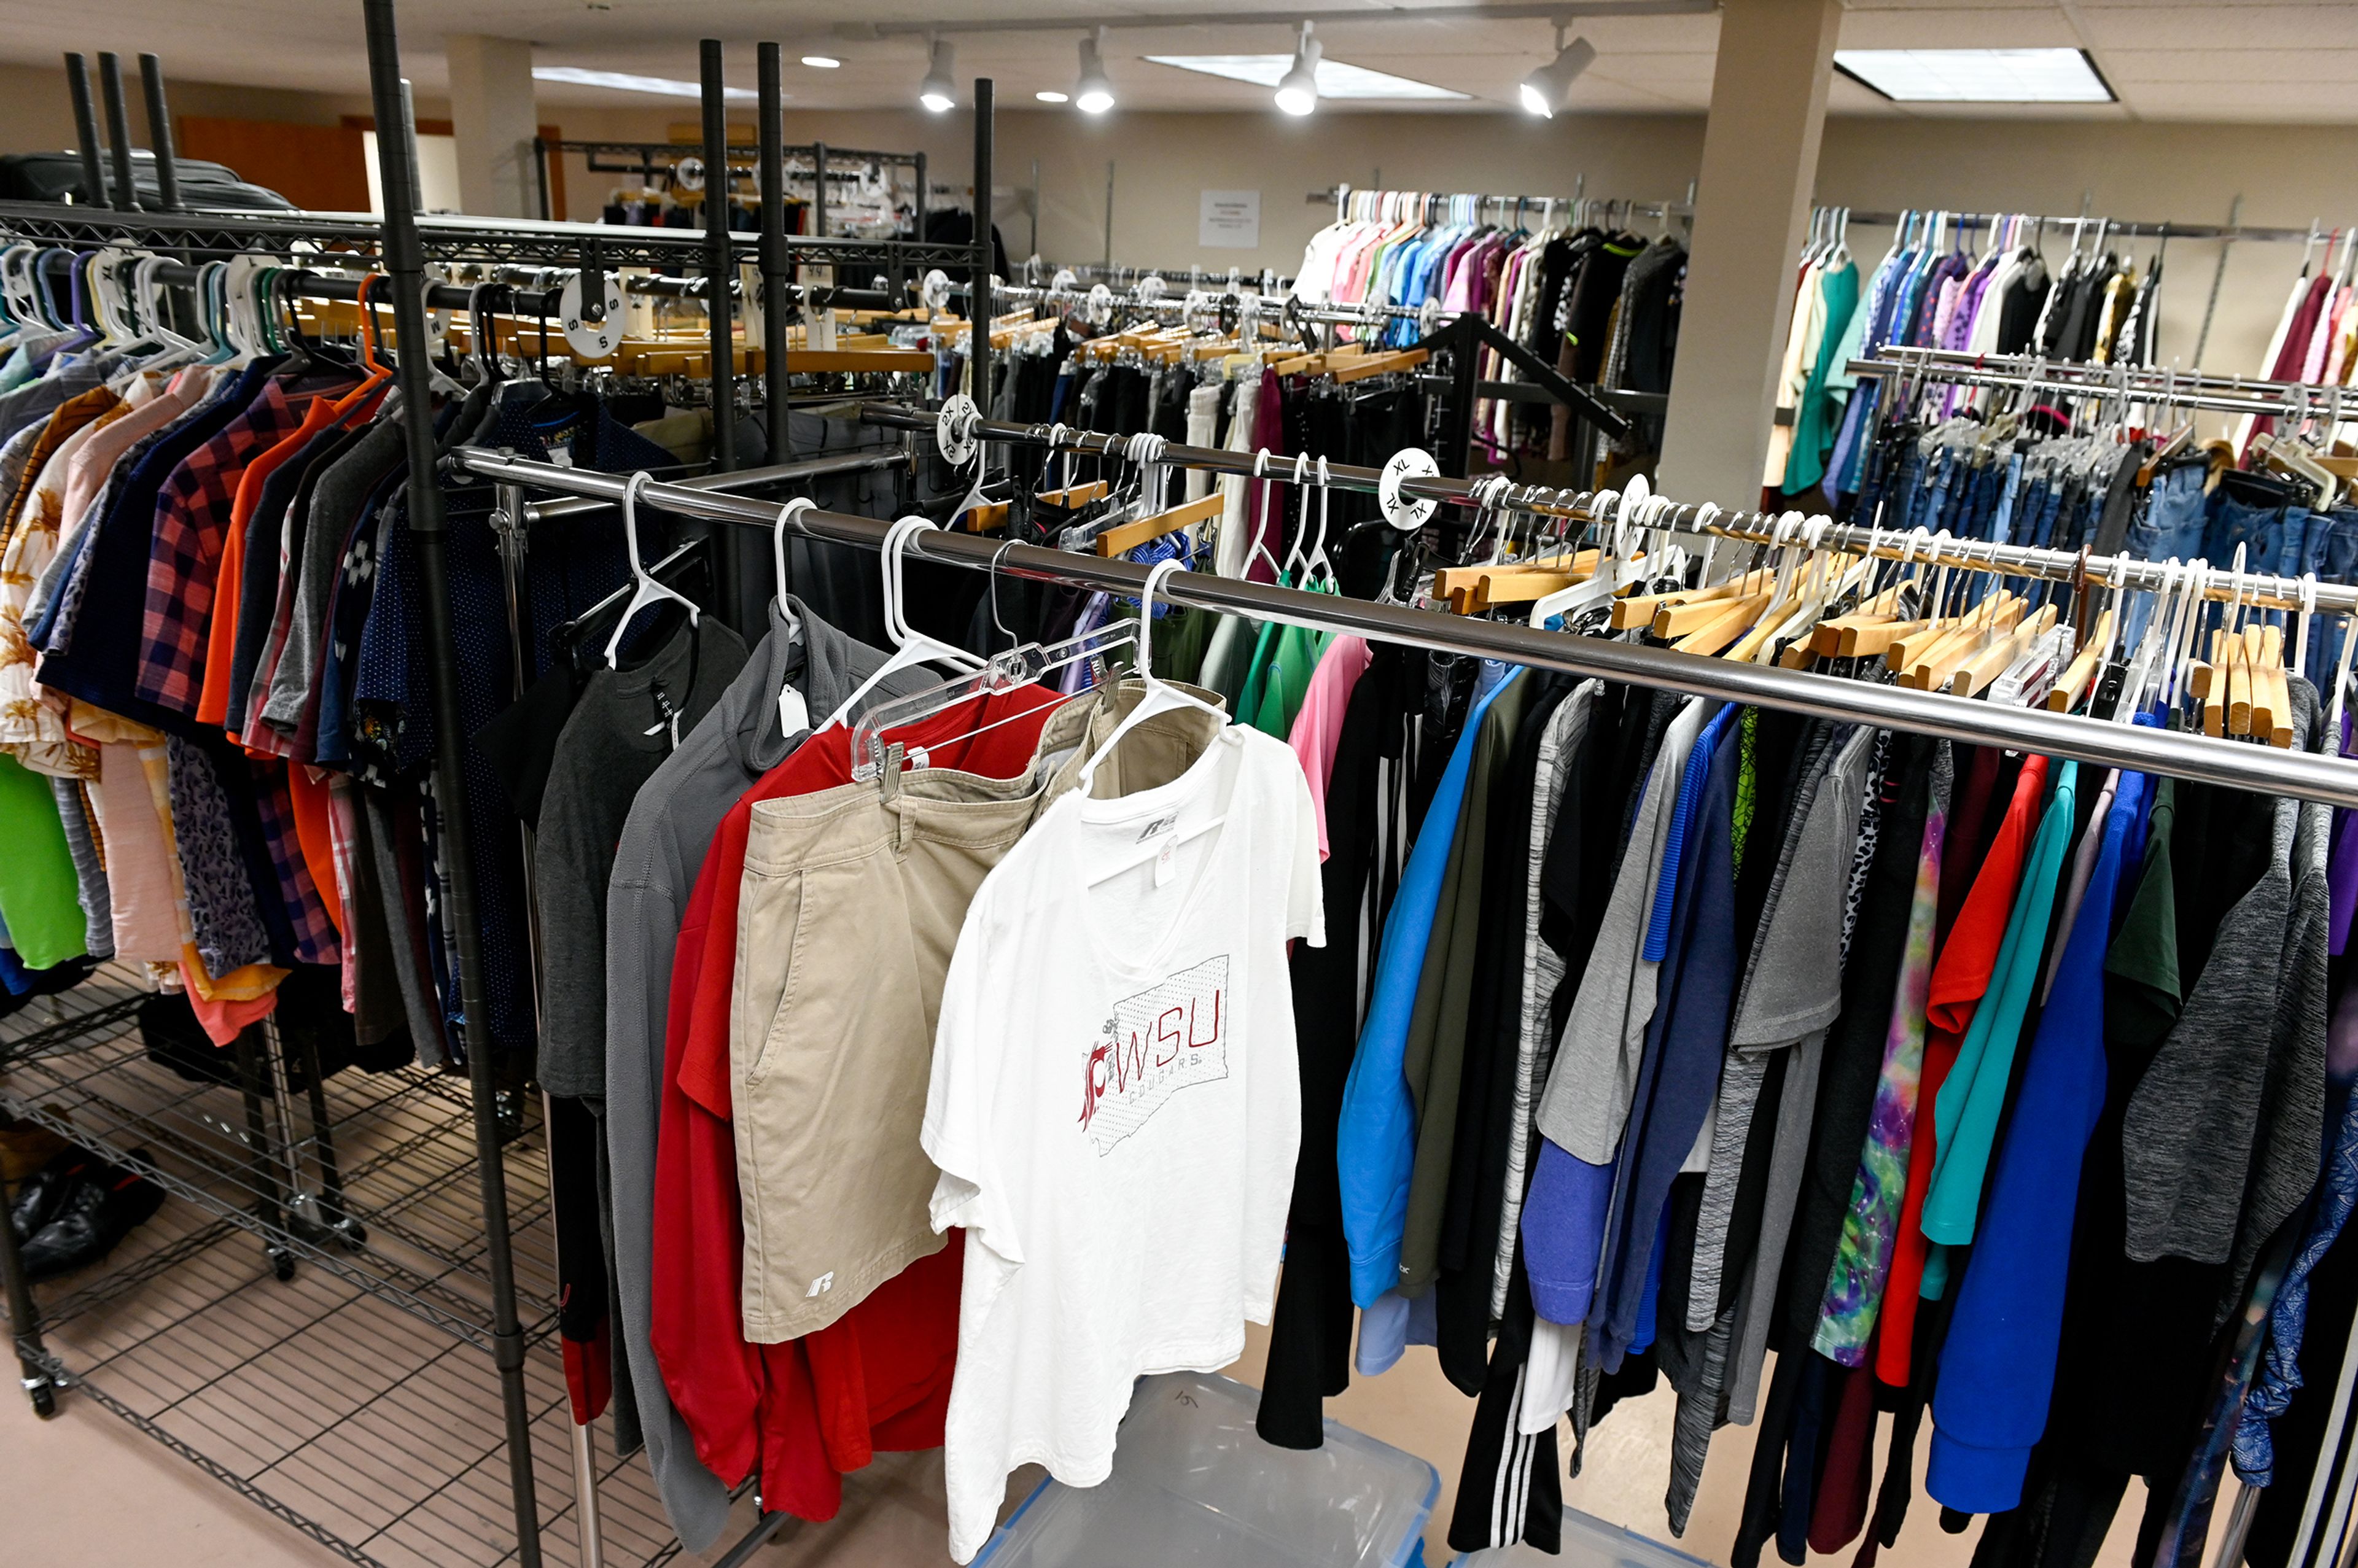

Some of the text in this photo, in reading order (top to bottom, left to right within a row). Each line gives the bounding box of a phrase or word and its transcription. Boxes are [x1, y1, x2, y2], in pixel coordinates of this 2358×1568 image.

[609, 298, 619, 310] S
[568, 319, 578, 331] S
[598, 336, 609, 348] S
[941, 405, 954, 426] 2X
[943, 440, 956, 459] 2X
[1393, 459, 1411, 476] XL
[1422, 464, 1434, 476] X
[1386, 492, 1400, 515] XL
[1410, 502, 1427, 520] XL
[1116, 989, 1220, 1093] WSU
[1129, 1054, 1198, 1104] COUGARS
